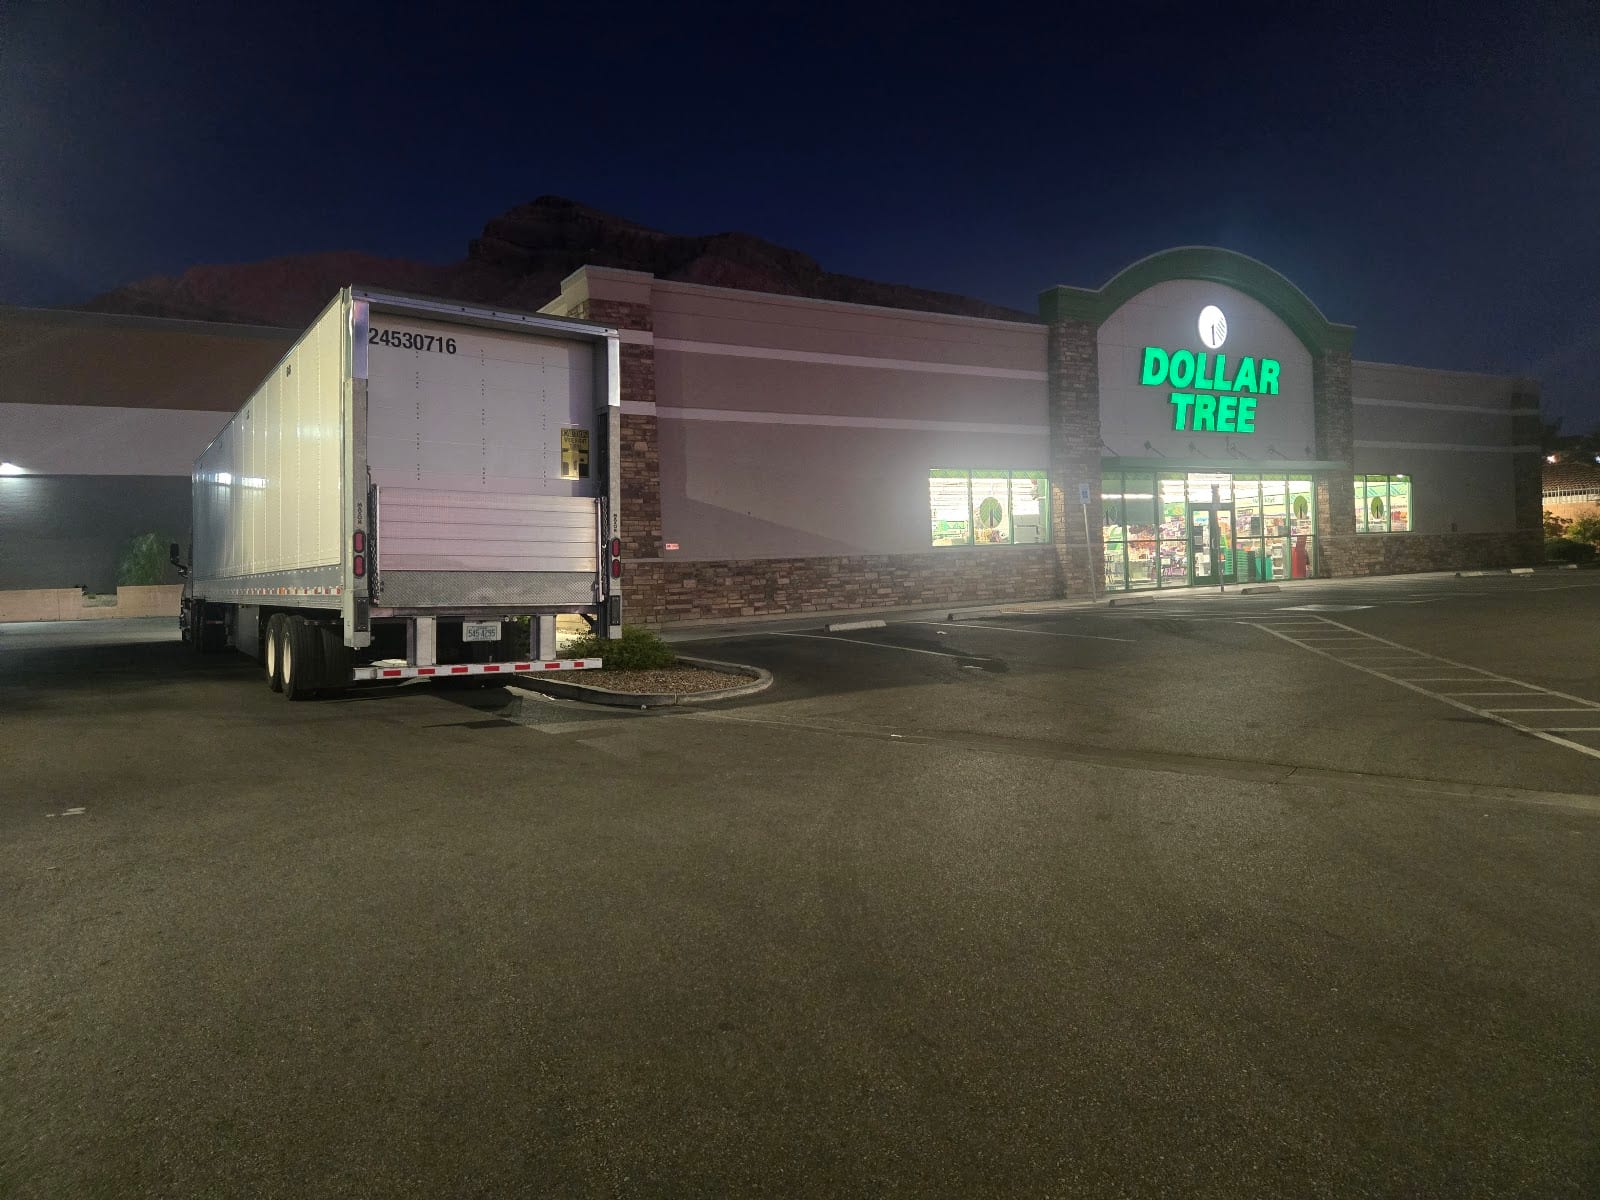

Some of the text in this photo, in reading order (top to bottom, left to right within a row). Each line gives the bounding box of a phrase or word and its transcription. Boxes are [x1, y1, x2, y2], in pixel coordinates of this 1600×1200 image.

[368, 327, 457, 354] 24530716
[1140, 346, 1281, 395] DOLLAR
[1170, 393, 1258, 433] TREE
